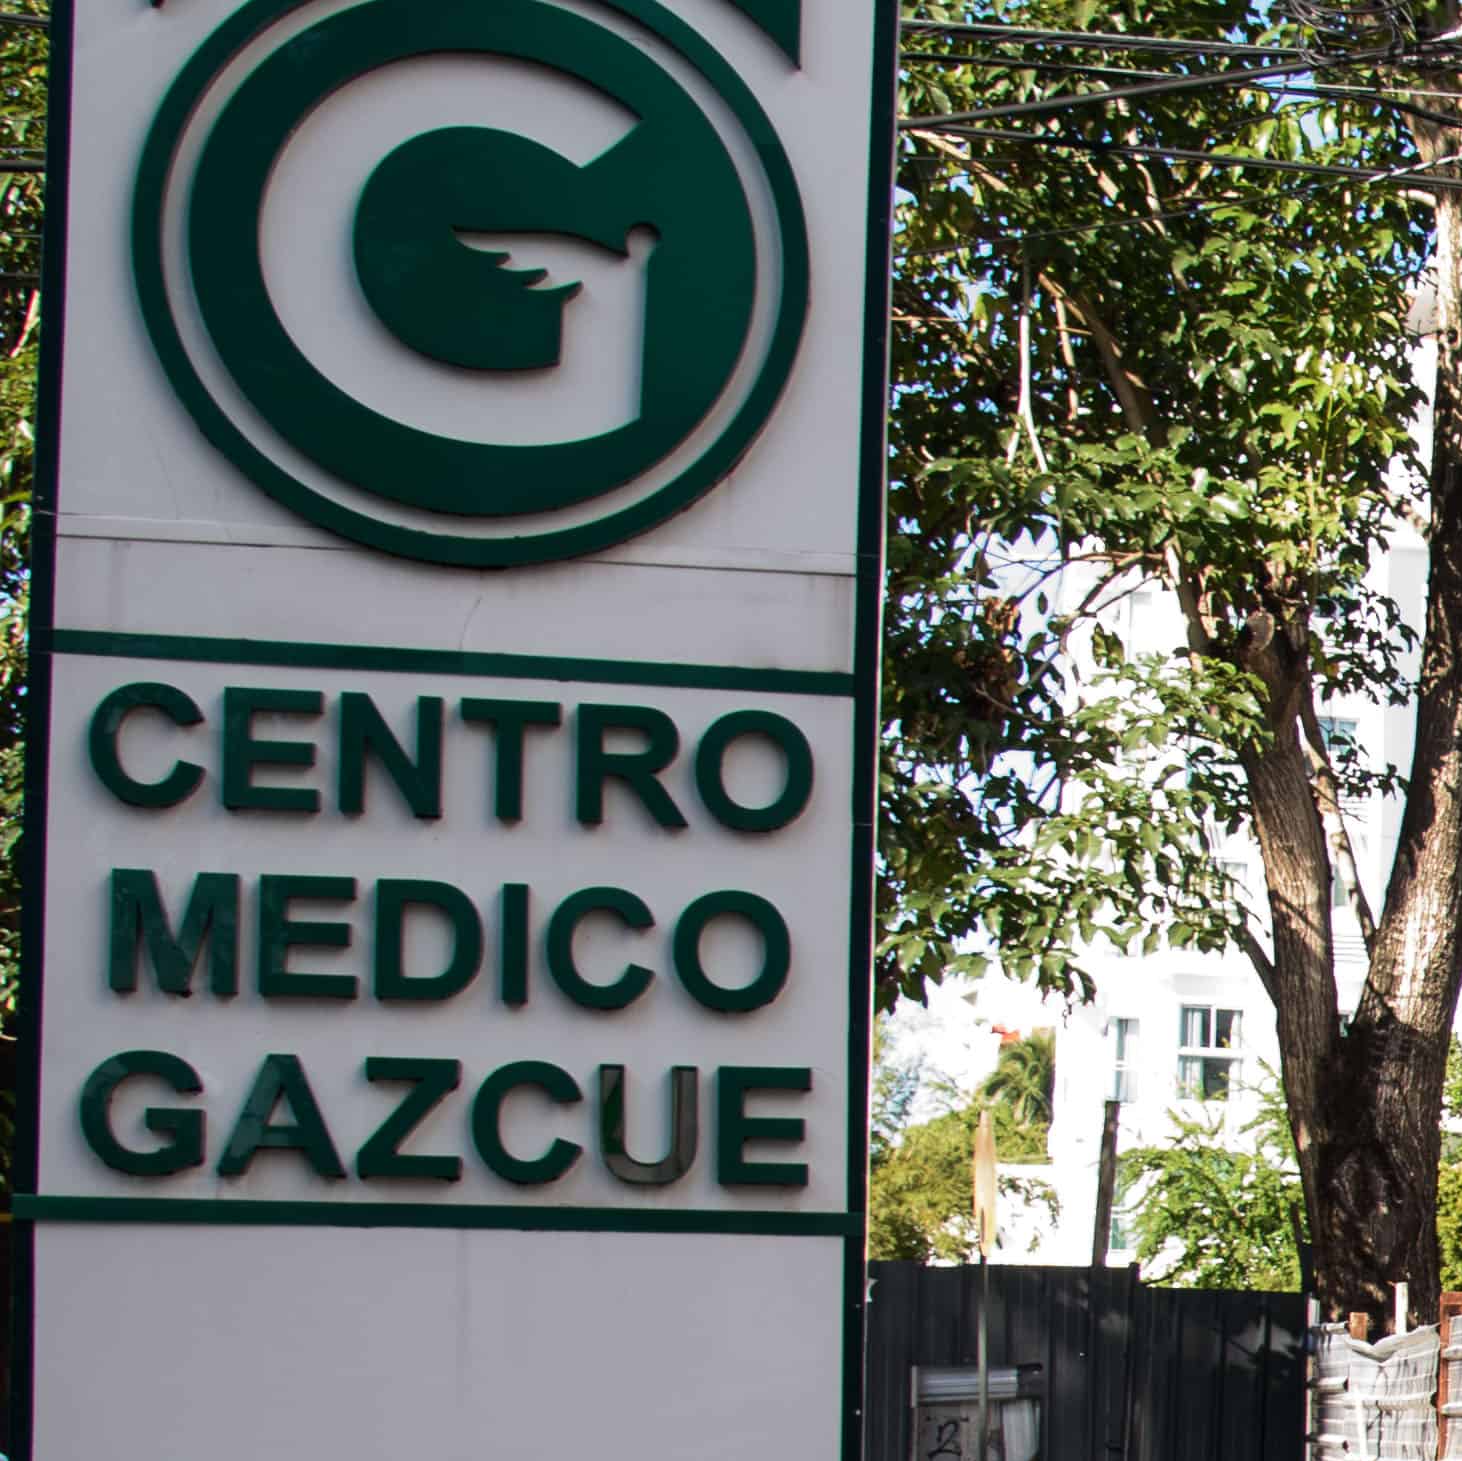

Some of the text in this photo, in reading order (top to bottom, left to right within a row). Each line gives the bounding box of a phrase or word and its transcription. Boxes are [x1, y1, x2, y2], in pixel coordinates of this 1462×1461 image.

[88, 681, 815, 833] CENTRO
[108, 867, 792, 1014] MEDICO
[79, 1049, 813, 1187] GAZCUE
